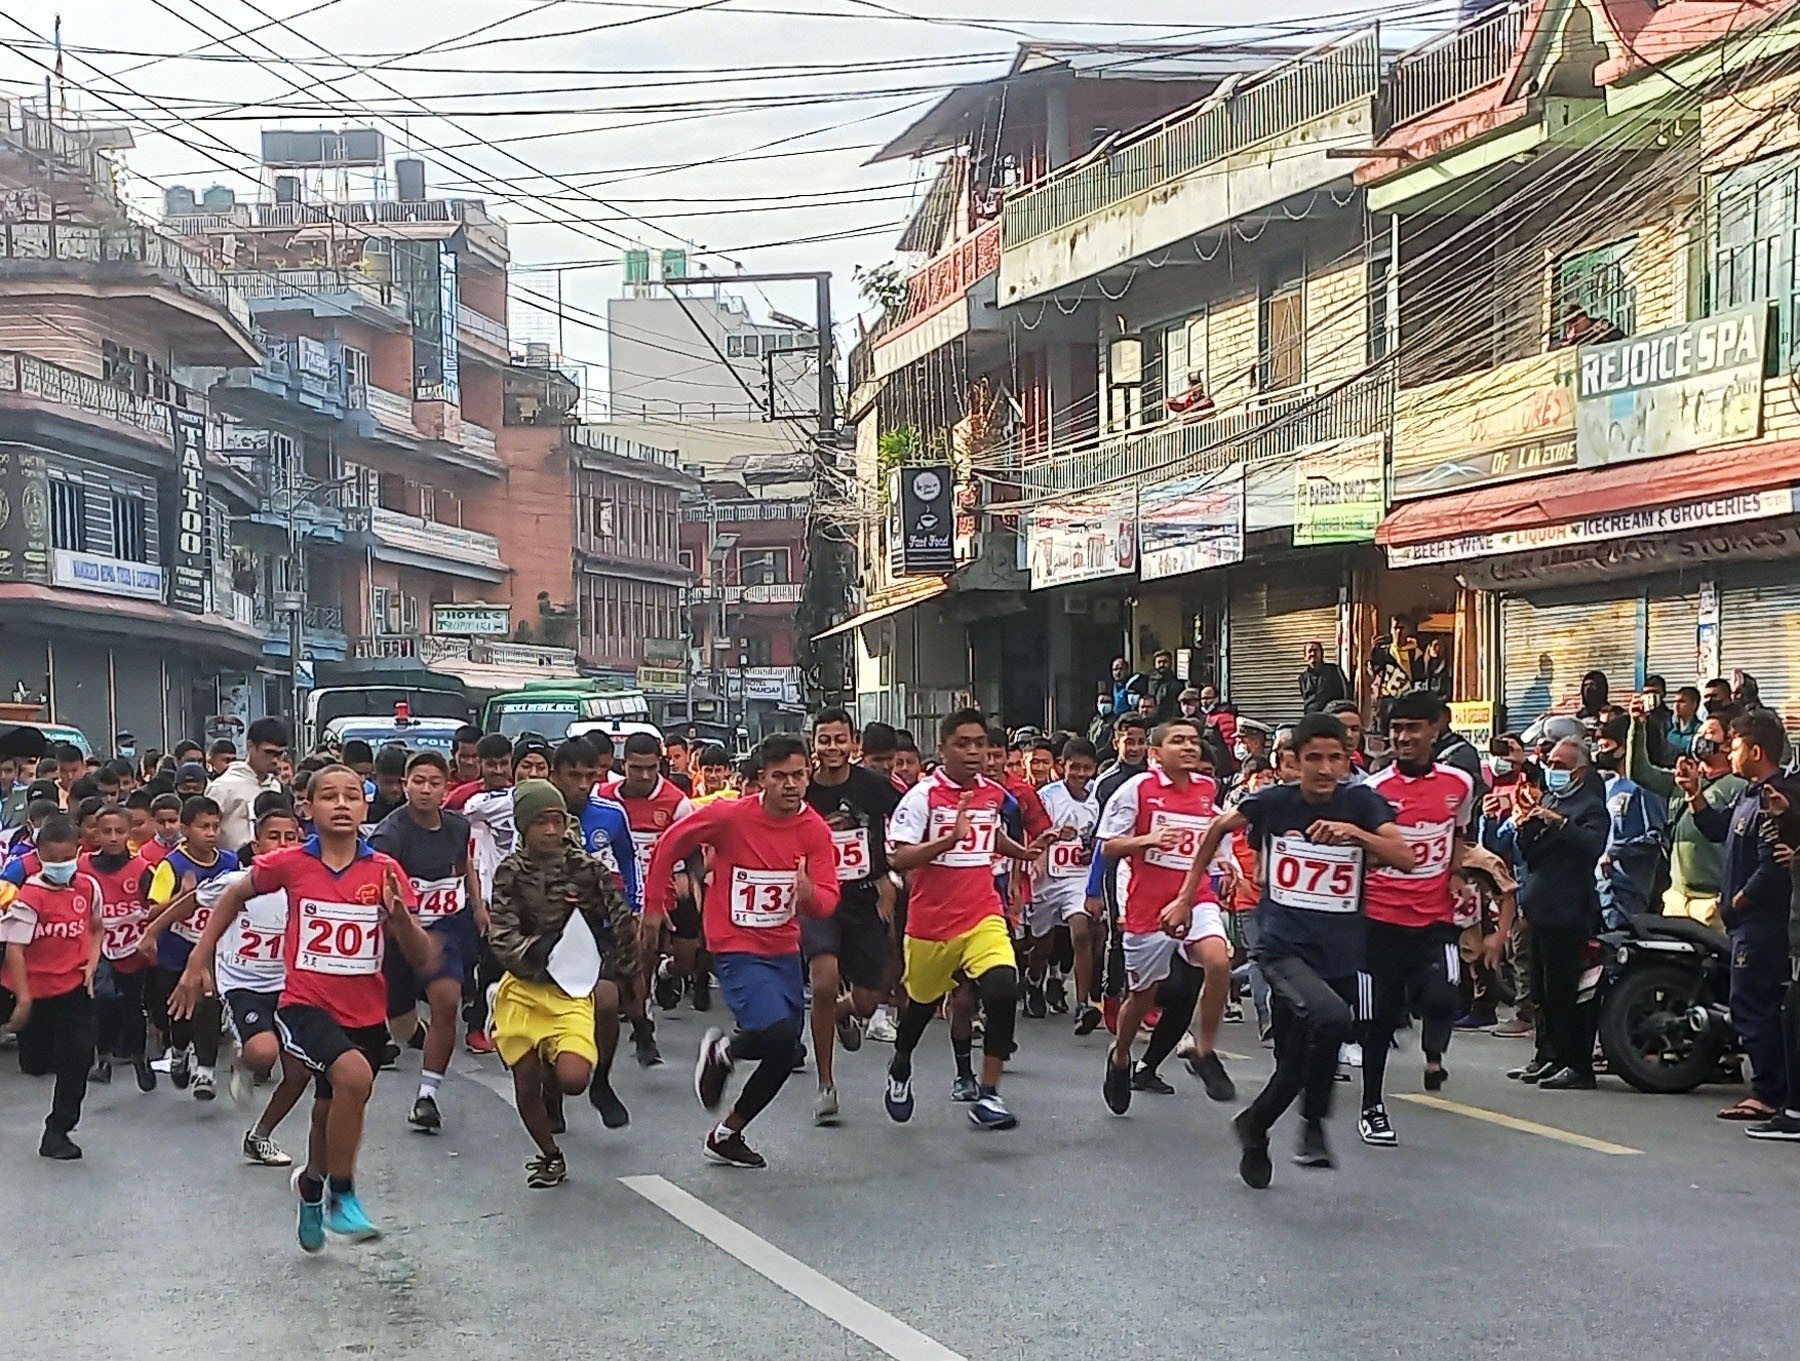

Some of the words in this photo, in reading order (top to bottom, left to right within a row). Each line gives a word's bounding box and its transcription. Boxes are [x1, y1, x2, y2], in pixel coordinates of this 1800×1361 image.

[1581, 330, 1693, 397] REJOICE
[1696, 314, 1758, 371] SPA
[179, 424, 203, 554] TATTOO
[1459, 535, 1494, 553] WINE
[1583, 512, 1654, 536] ICECREAM
[1671, 494, 1761, 523] GROCERIES
[446, 611, 491, 620] HOTEL
[1277, 856, 1354, 895] 075
[307, 920, 379, 956] 201
